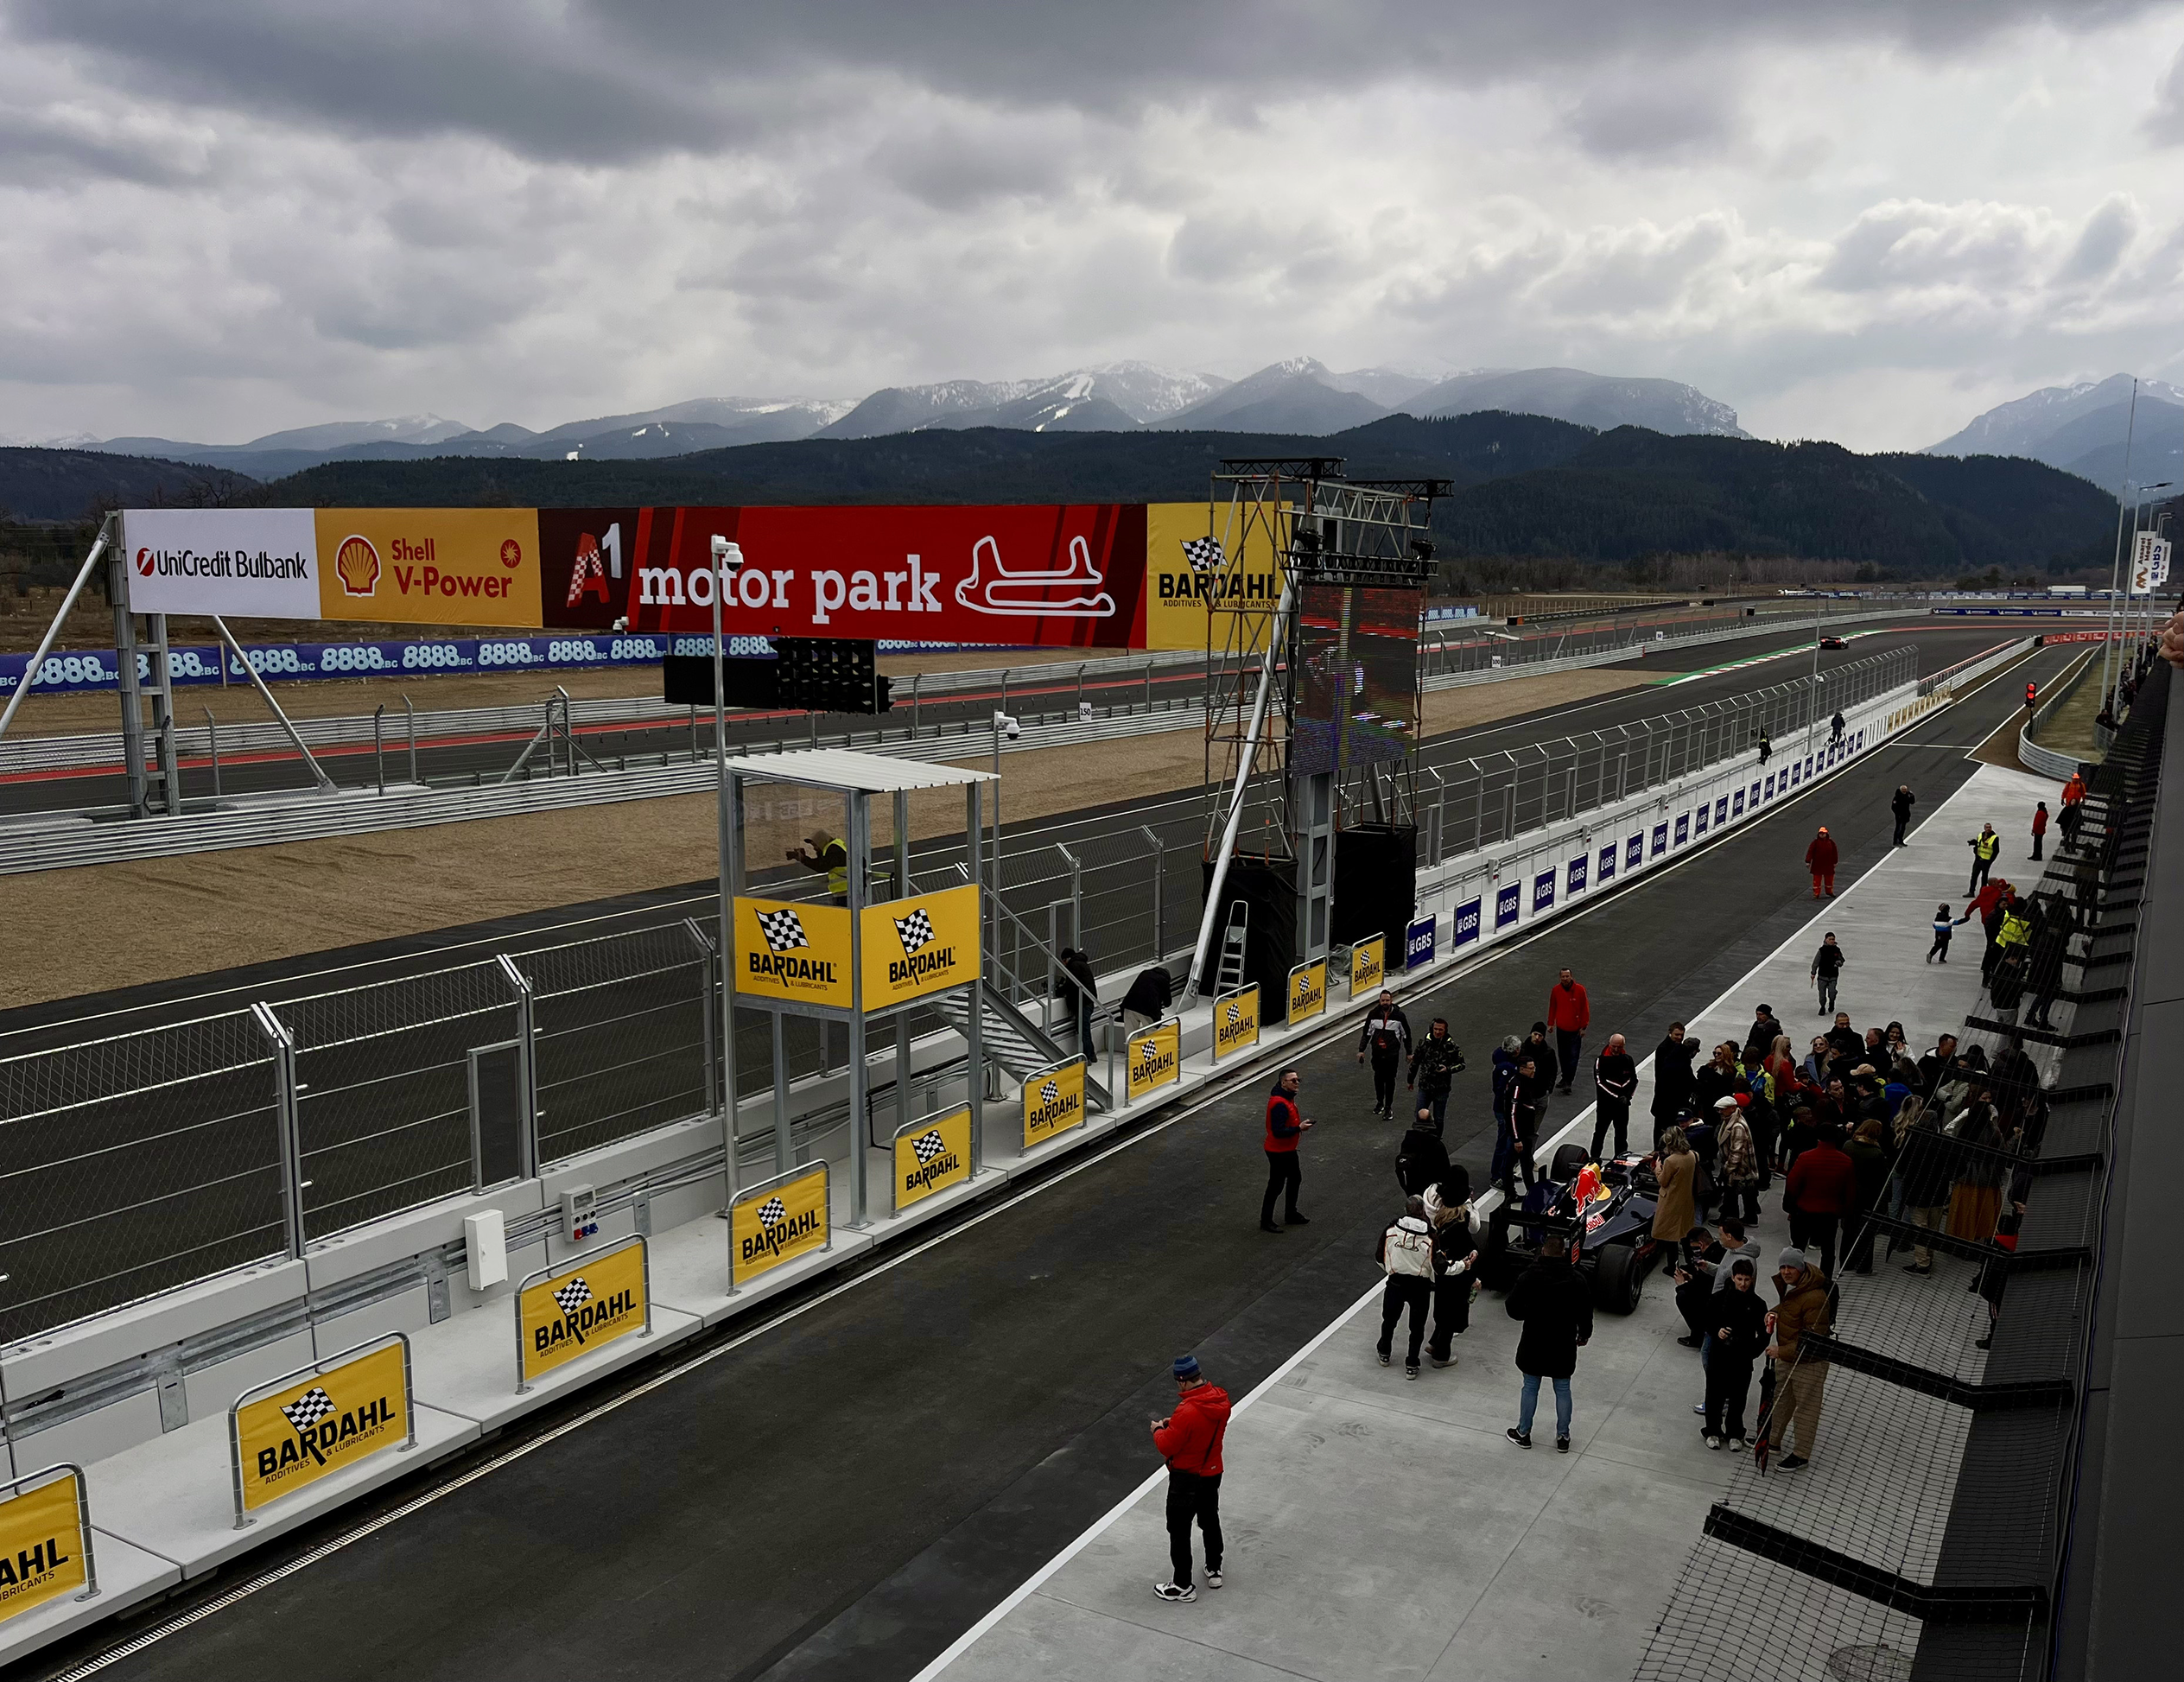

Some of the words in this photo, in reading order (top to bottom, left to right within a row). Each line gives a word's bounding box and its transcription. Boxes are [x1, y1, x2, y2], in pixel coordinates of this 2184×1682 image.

[156, 549, 232, 578] UniCredit
[235, 550, 308, 579] Bulbank
[391, 538, 435, 562] Shell
[2151, 545, 2162, 570] GBS
[392, 566, 512, 598] V-Power
[567, 523, 622, 607] A1
[638, 557, 794, 608] motor
[811, 555, 942, 624] park
[321, 647, 398, 671] 8888.BG
[403, 644, 473, 669] 8888.BG
[478, 643, 544, 665] 8888.BG
[1573, 866, 1585, 882] GBS
[1540, 881, 1552, 898] GBS
[1504, 896, 1517, 914] GBS
[1463, 912, 1478, 931] GBS
[1415, 932, 1432, 951] GBS
[749, 952, 837, 987] BARDAHL
[889, 947, 956, 985] BARDAHL
[1355, 962, 1381, 985] BARDAHL
[1292, 987, 1322, 1012] BARDAHL
[1219, 1015, 1255, 1044] BARDAHL
[1133, 1051, 1175, 1083] BARDAHL
[1030, 1093, 1080, 1129] BARDAHL
[906, 1154, 960, 1191] BARDAHL
[742, 1209, 821, 1260] BARDAHL
[535, 1289, 637, 1352] BARDAHL
[540, 1337, 574, 1358] ADDITIVES
[591, 1312, 629, 1334] LUBRICANTS
[257, 1397, 396, 1478] BARDAHL
[264, 1459, 311, 1485] ADDITIVES
[334, 1425, 385, 1453] LUBRICANTS
[0, 1571, 55, 1602] BRICANTS
